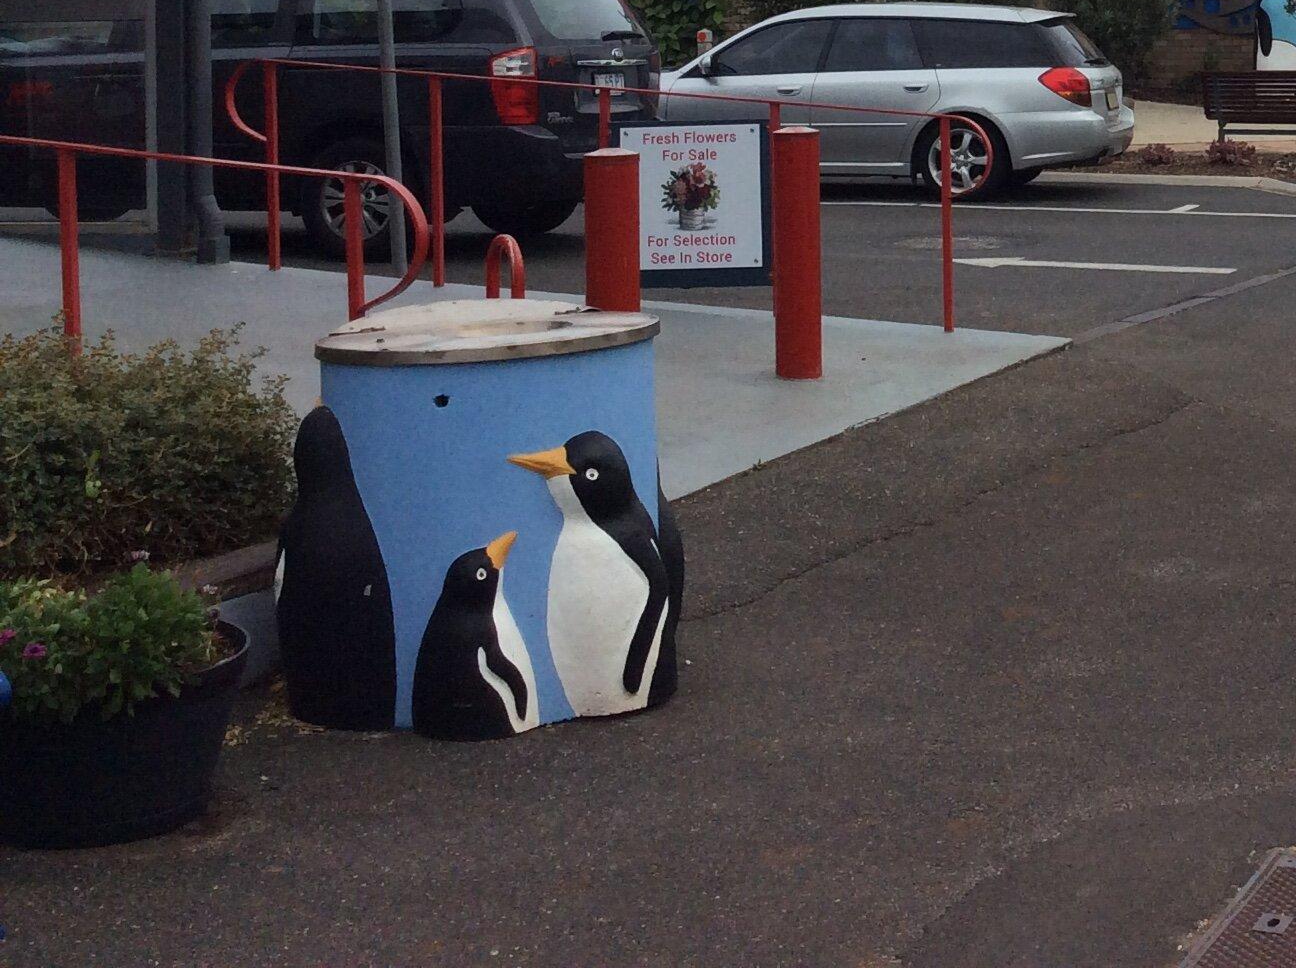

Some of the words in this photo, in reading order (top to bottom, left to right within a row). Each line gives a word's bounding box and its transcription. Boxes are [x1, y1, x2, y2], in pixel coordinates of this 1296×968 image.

[643, 132, 680, 145] Fresh
[684, 131, 737, 144] Flowers
[662, 149, 684, 161] For
[688, 148, 718, 161] Sale
[647, 235, 669, 247] For
[673, 234, 736, 247] Selection
[650, 252, 676, 265] See
[680, 252, 692, 263] In
[696, 251, 733, 263] Store
